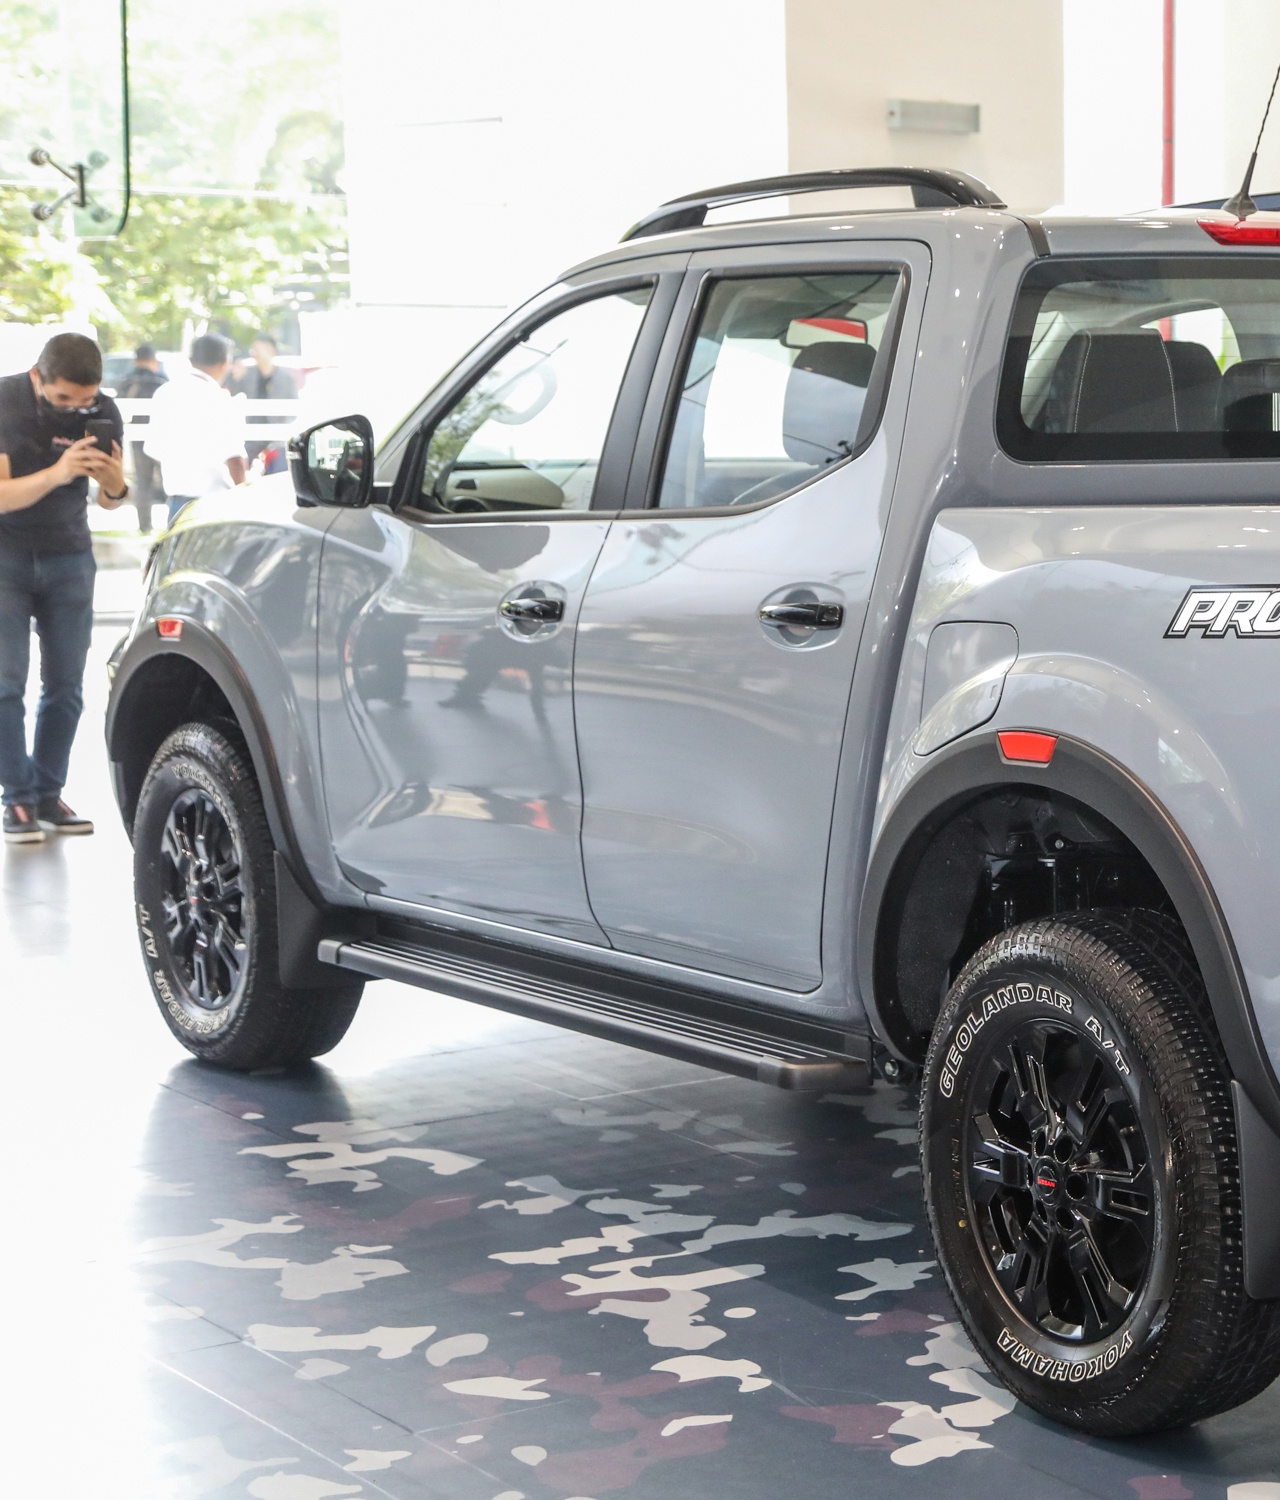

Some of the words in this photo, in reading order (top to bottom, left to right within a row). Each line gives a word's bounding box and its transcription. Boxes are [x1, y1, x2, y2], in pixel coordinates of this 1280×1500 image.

[939, 983, 1074, 1098] GEOLANDAR
[1084, 1015, 1131, 1076] A/T
[996, 1326, 1136, 1383] YOKOHAMA
